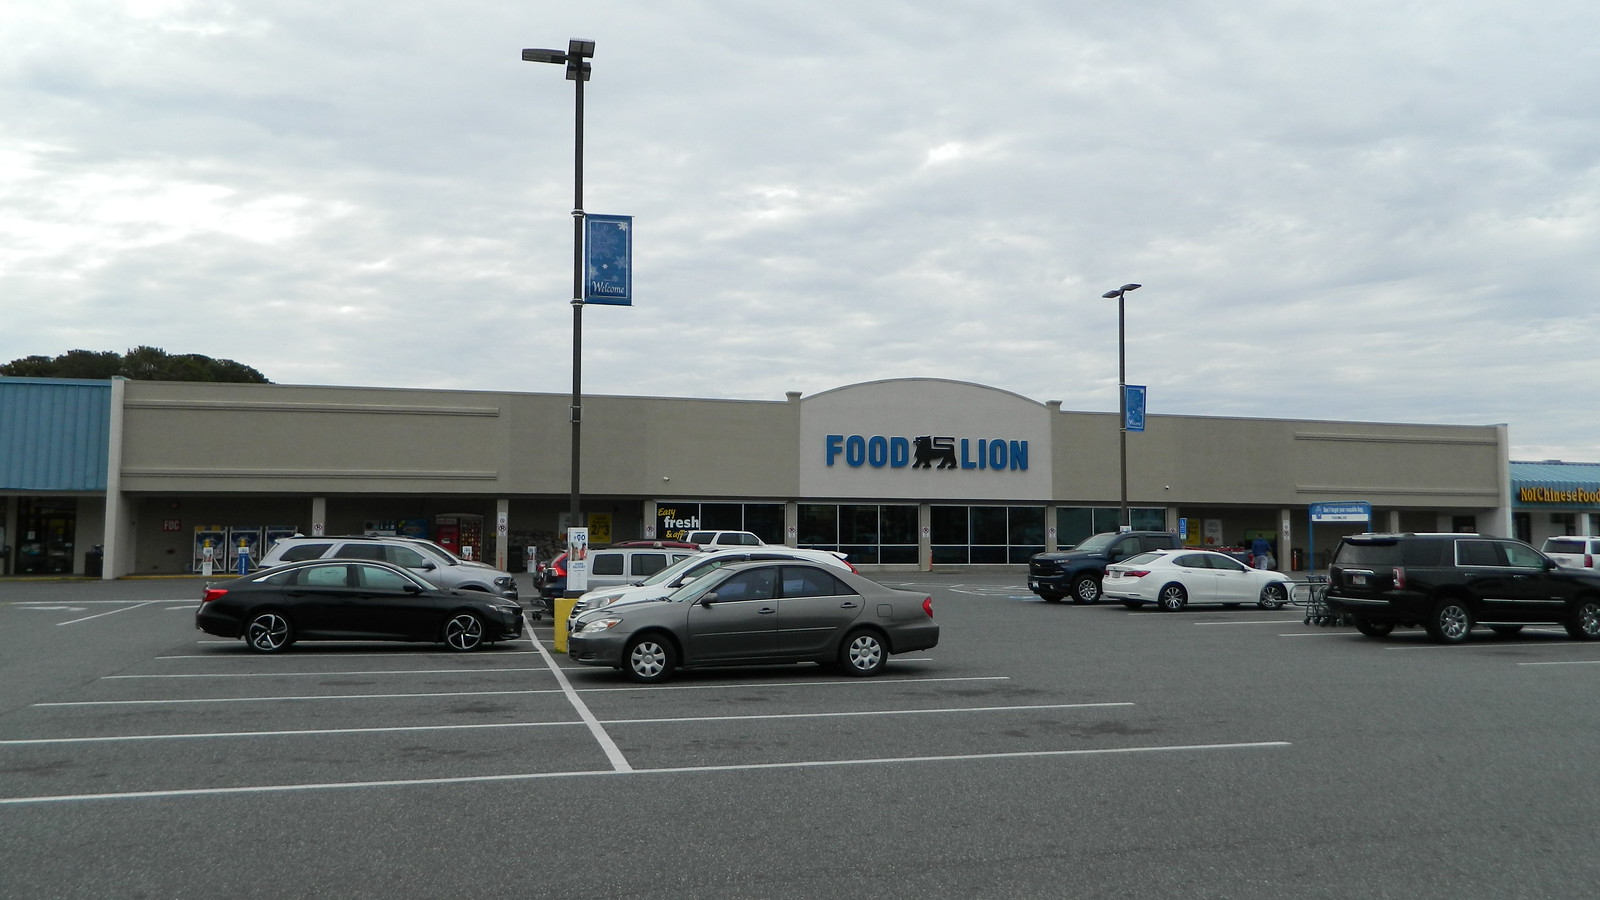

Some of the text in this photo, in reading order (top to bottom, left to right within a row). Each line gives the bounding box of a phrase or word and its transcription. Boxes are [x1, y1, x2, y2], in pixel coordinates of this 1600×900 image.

[592, 281, 625, 294] Welcome
[826, 435, 1029, 471] FOOD LION
[658, 508, 676, 519] Easy
[664, 516, 699, 528] fresh
[666, 530, 672, 538] &
